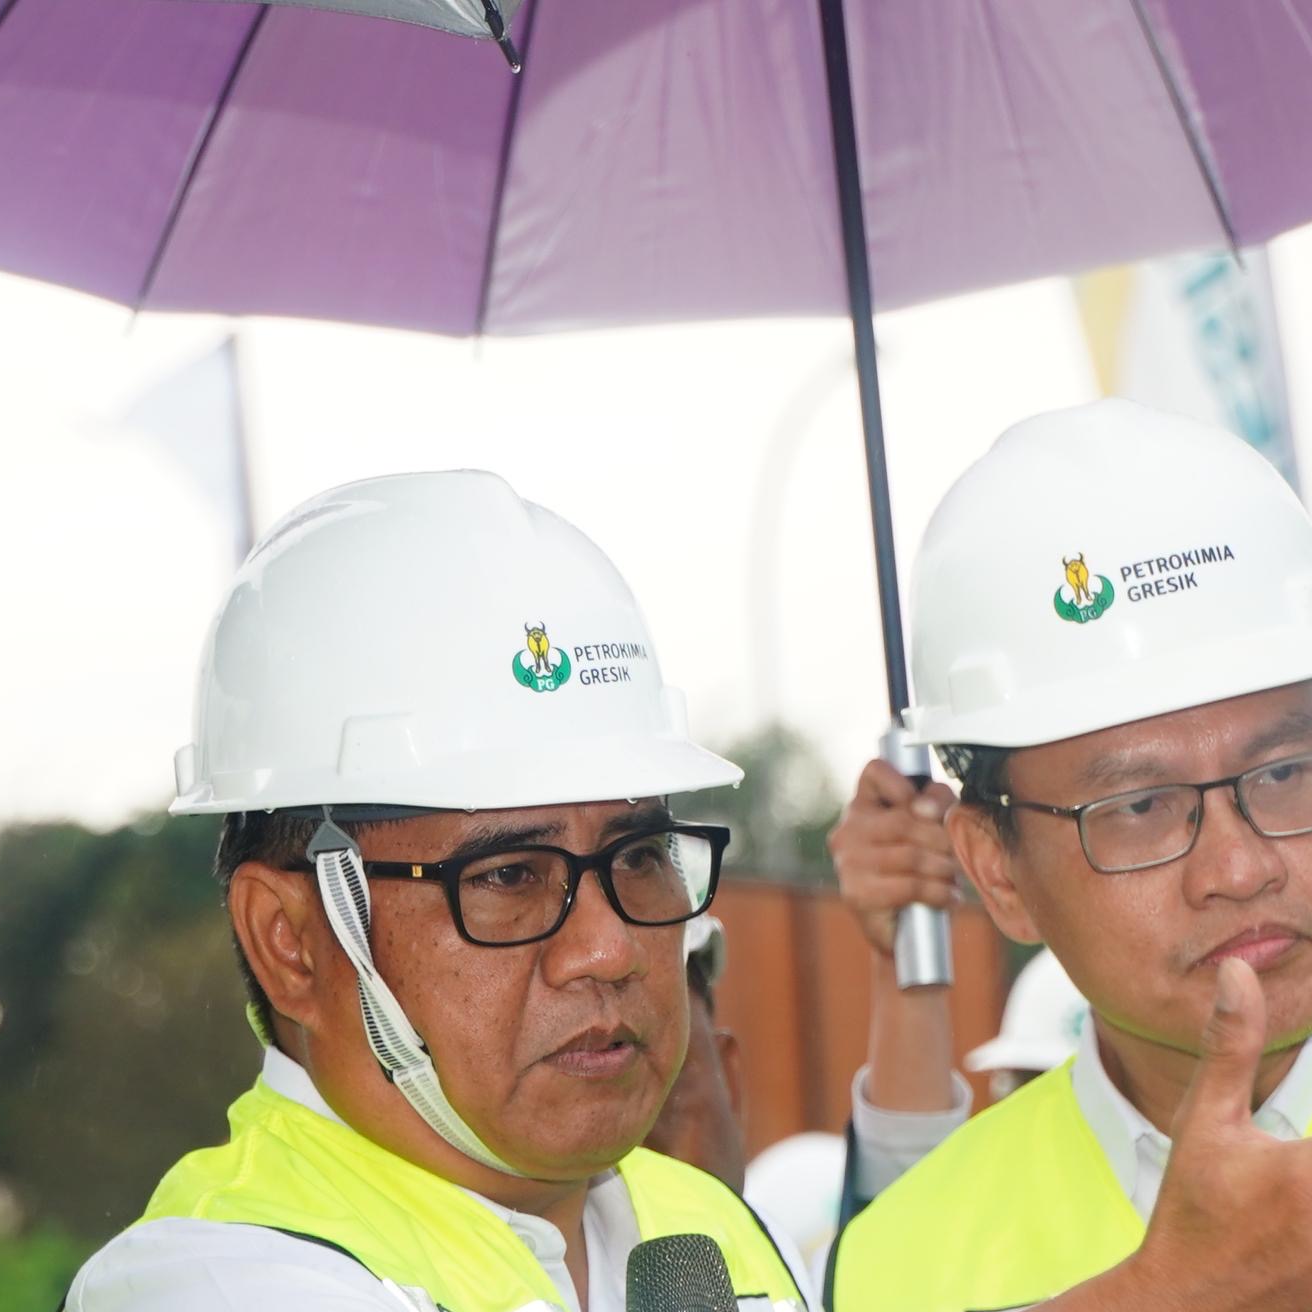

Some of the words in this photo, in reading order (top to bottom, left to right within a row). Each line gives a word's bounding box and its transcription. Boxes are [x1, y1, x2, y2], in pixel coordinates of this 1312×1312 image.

[1120, 545, 1235, 582] PETROKIMIA
[1127, 572, 1198, 602] GRESIK
[574, 643, 648, 662] PETROKIMIA
[537, 678, 554, 691] PG
[580, 666, 631, 685] GRESIK
